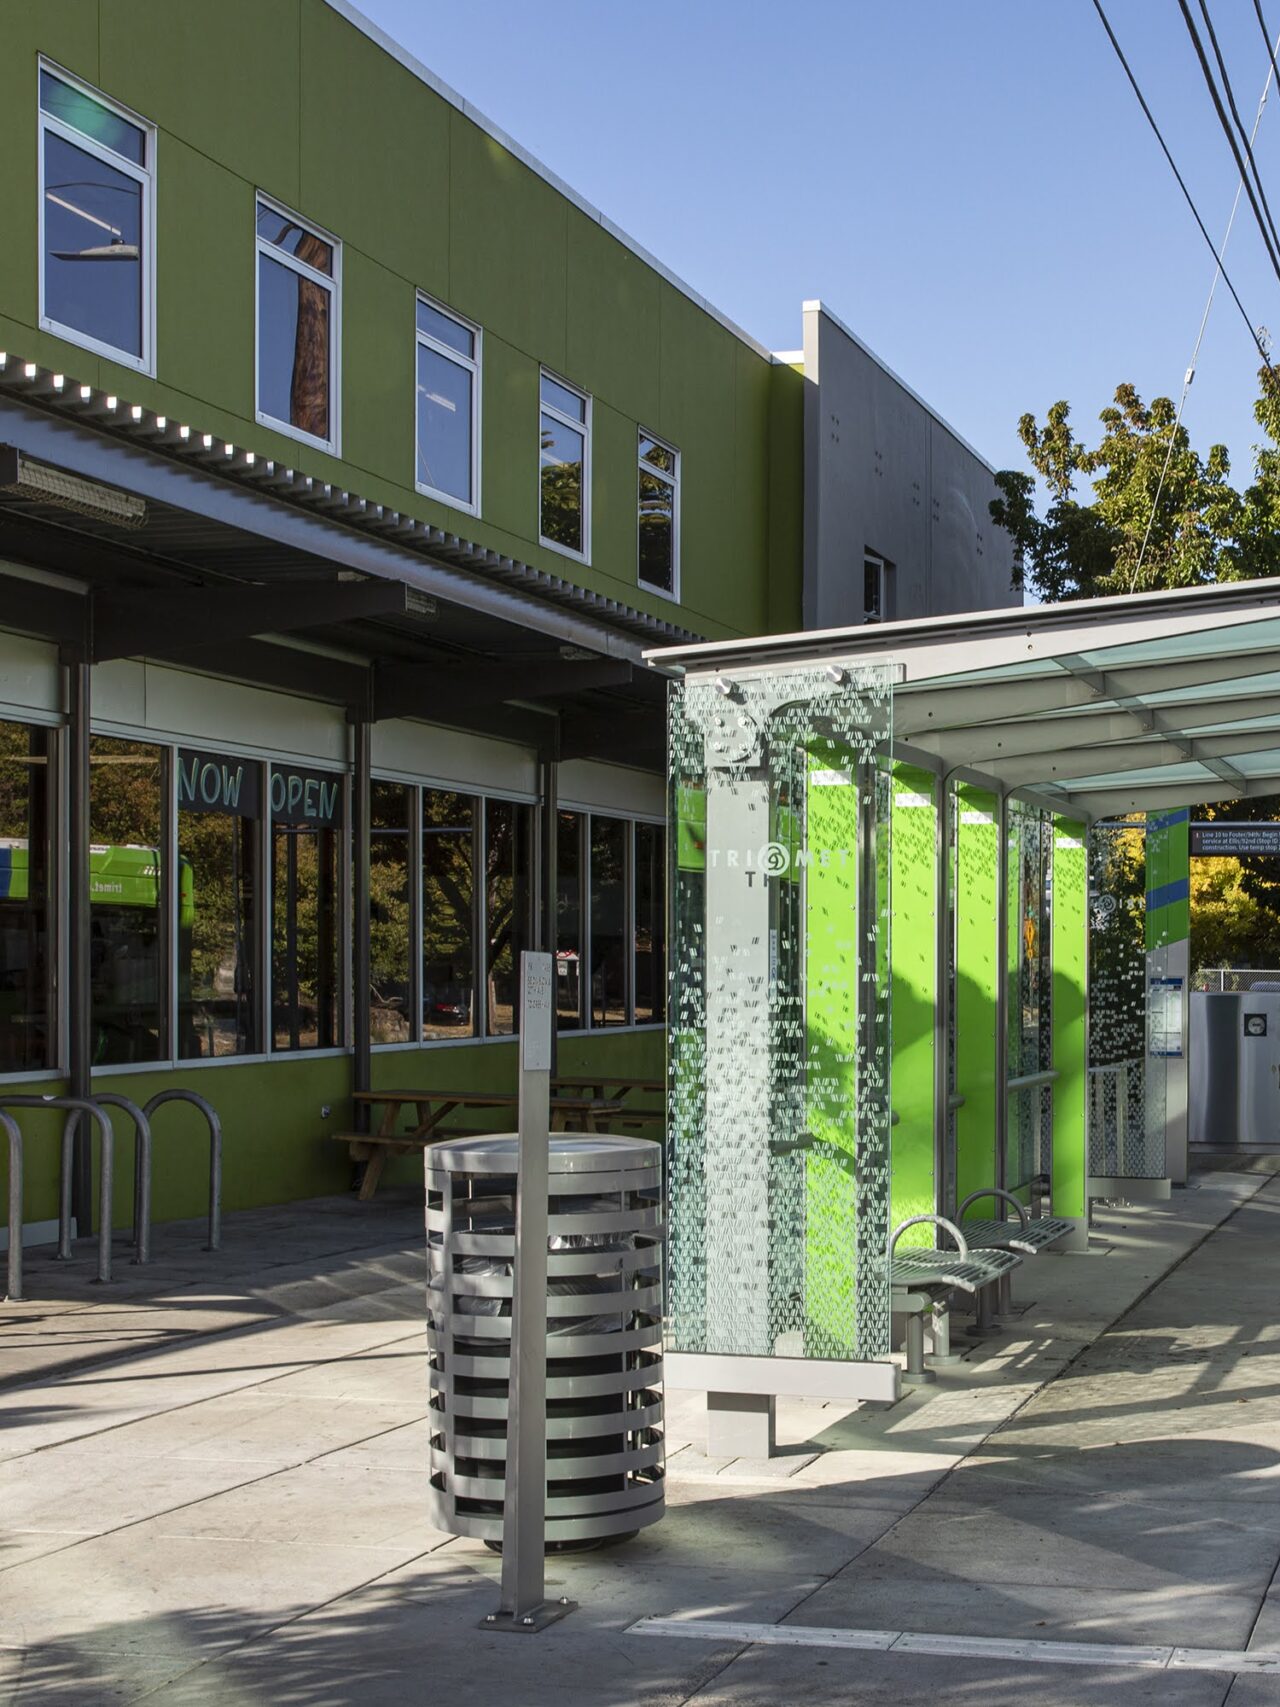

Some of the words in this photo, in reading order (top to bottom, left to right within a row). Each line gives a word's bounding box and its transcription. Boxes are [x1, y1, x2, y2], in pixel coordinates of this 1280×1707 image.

[178, 757, 243, 807] NOW
[271, 772, 338, 819] OPEN
[708, 850, 752, 867] TRI
[795, 849, 849, 868] MET
